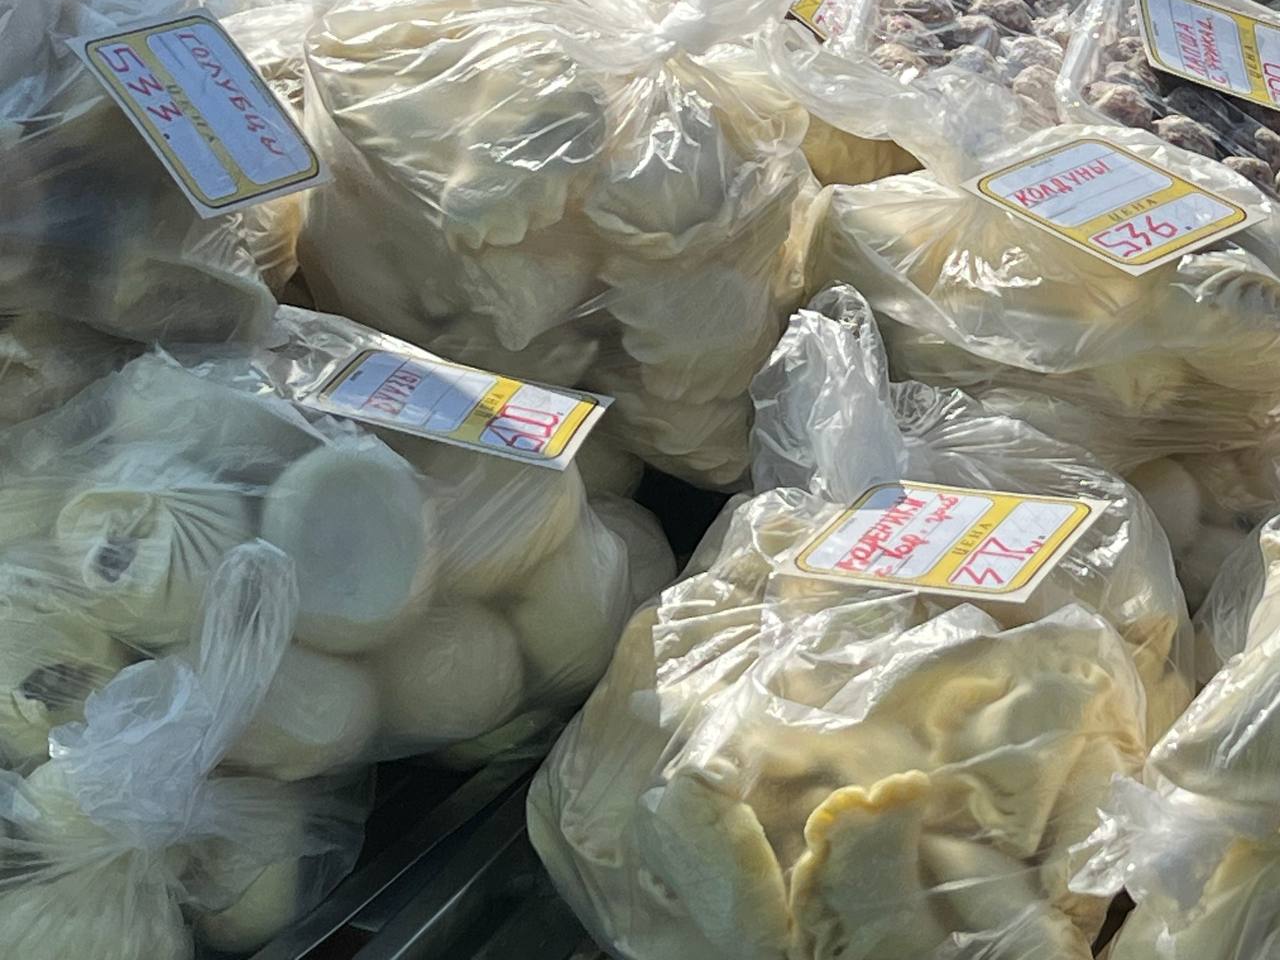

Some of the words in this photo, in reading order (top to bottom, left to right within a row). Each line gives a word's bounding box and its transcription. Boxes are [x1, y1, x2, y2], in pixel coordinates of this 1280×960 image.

[1173, 21, 1206, 76] ЛАПША
[95, 47, 183, 122] 533
[178, 32, 285, 156] ГОЛУБЦЫ
[1014, 159, 1112, 207] КОЛДУНЫ
[1109, 198, 1159, 223] ЦЕНА
[1092, 215, 1179, 258] 536
[952, 522, 993, 556] ЦЕНА
